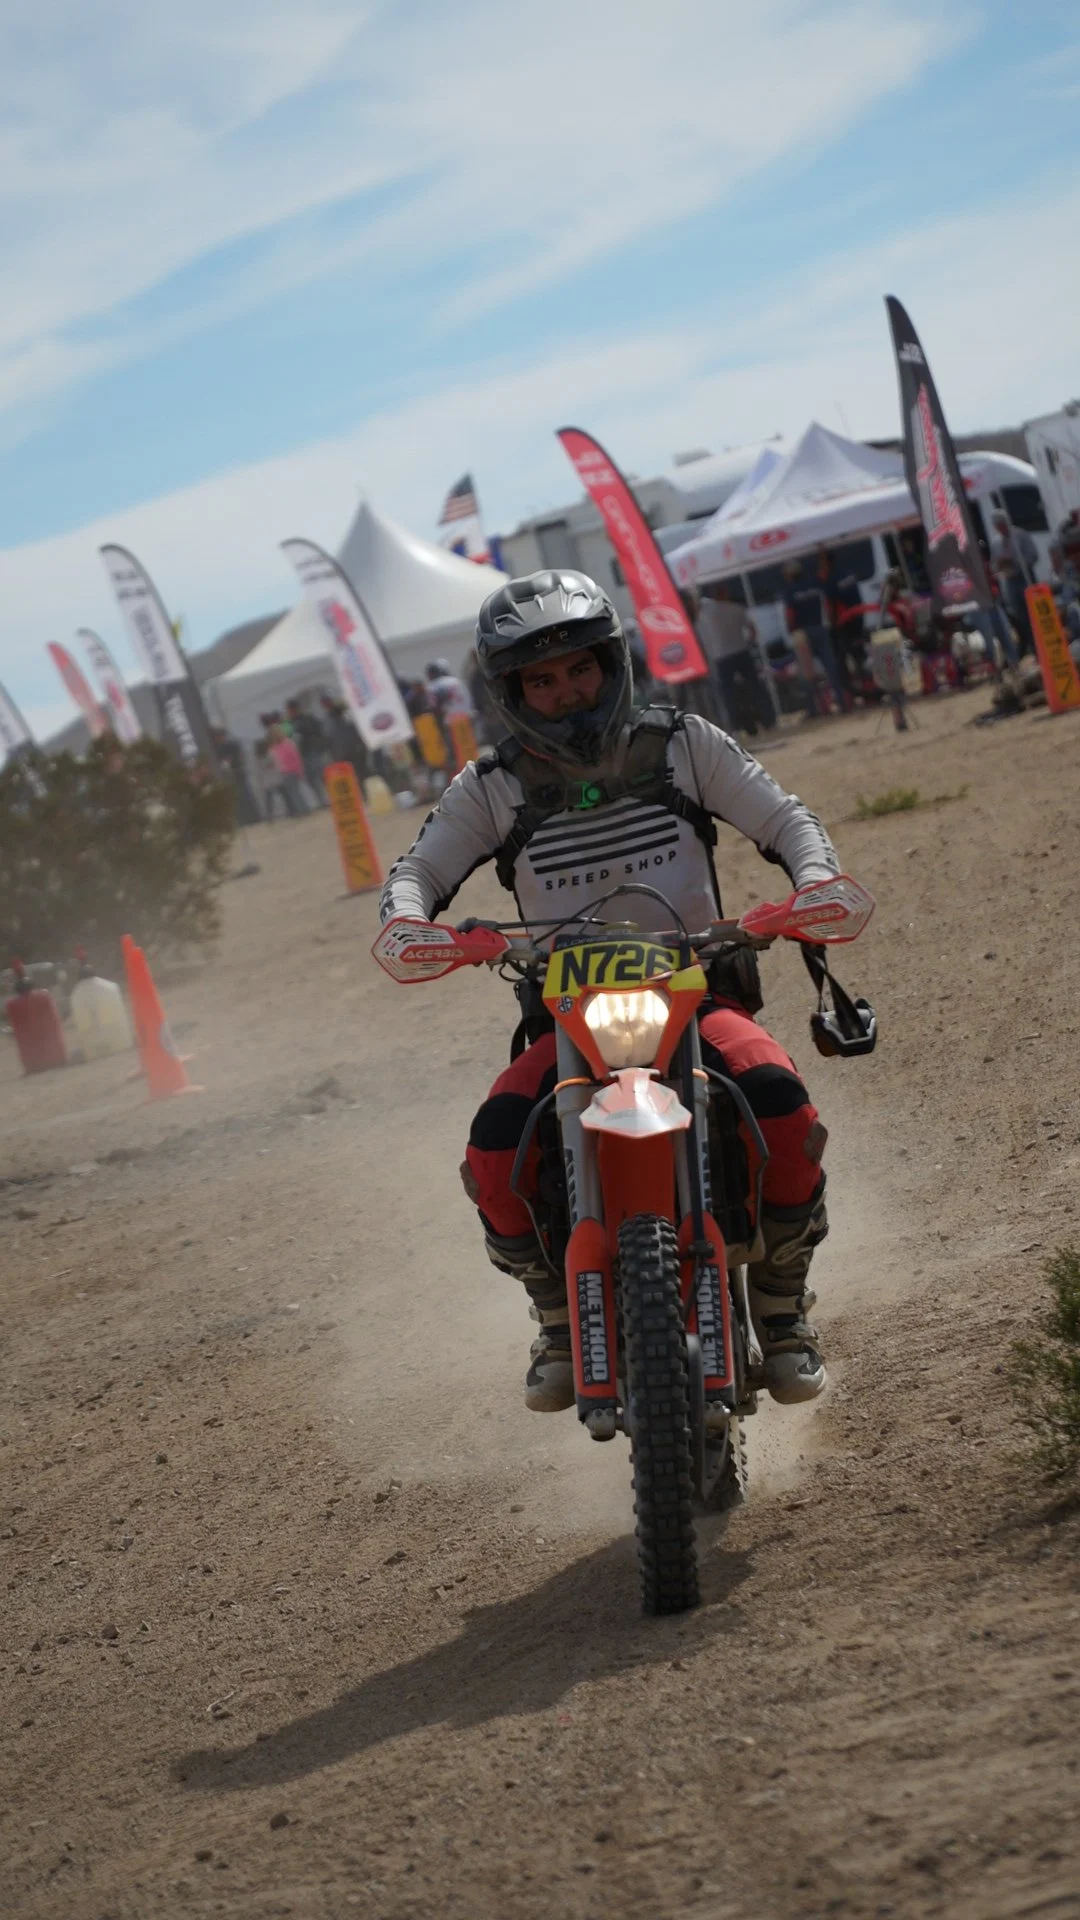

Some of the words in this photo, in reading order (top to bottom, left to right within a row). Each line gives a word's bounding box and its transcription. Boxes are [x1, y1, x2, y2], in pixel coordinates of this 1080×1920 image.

[545, 868, 610, 890] SPEED
[624, 850, 677, 874] SHOP
[560, 943, 675, 993] N726
[577, 1273, 588, 1312] RACE
[696, 1265, 718, 1375] METHOD
[580, 1319, 592, 1383] WHEELS
[585, 1272, 609, 1382] METHOD
